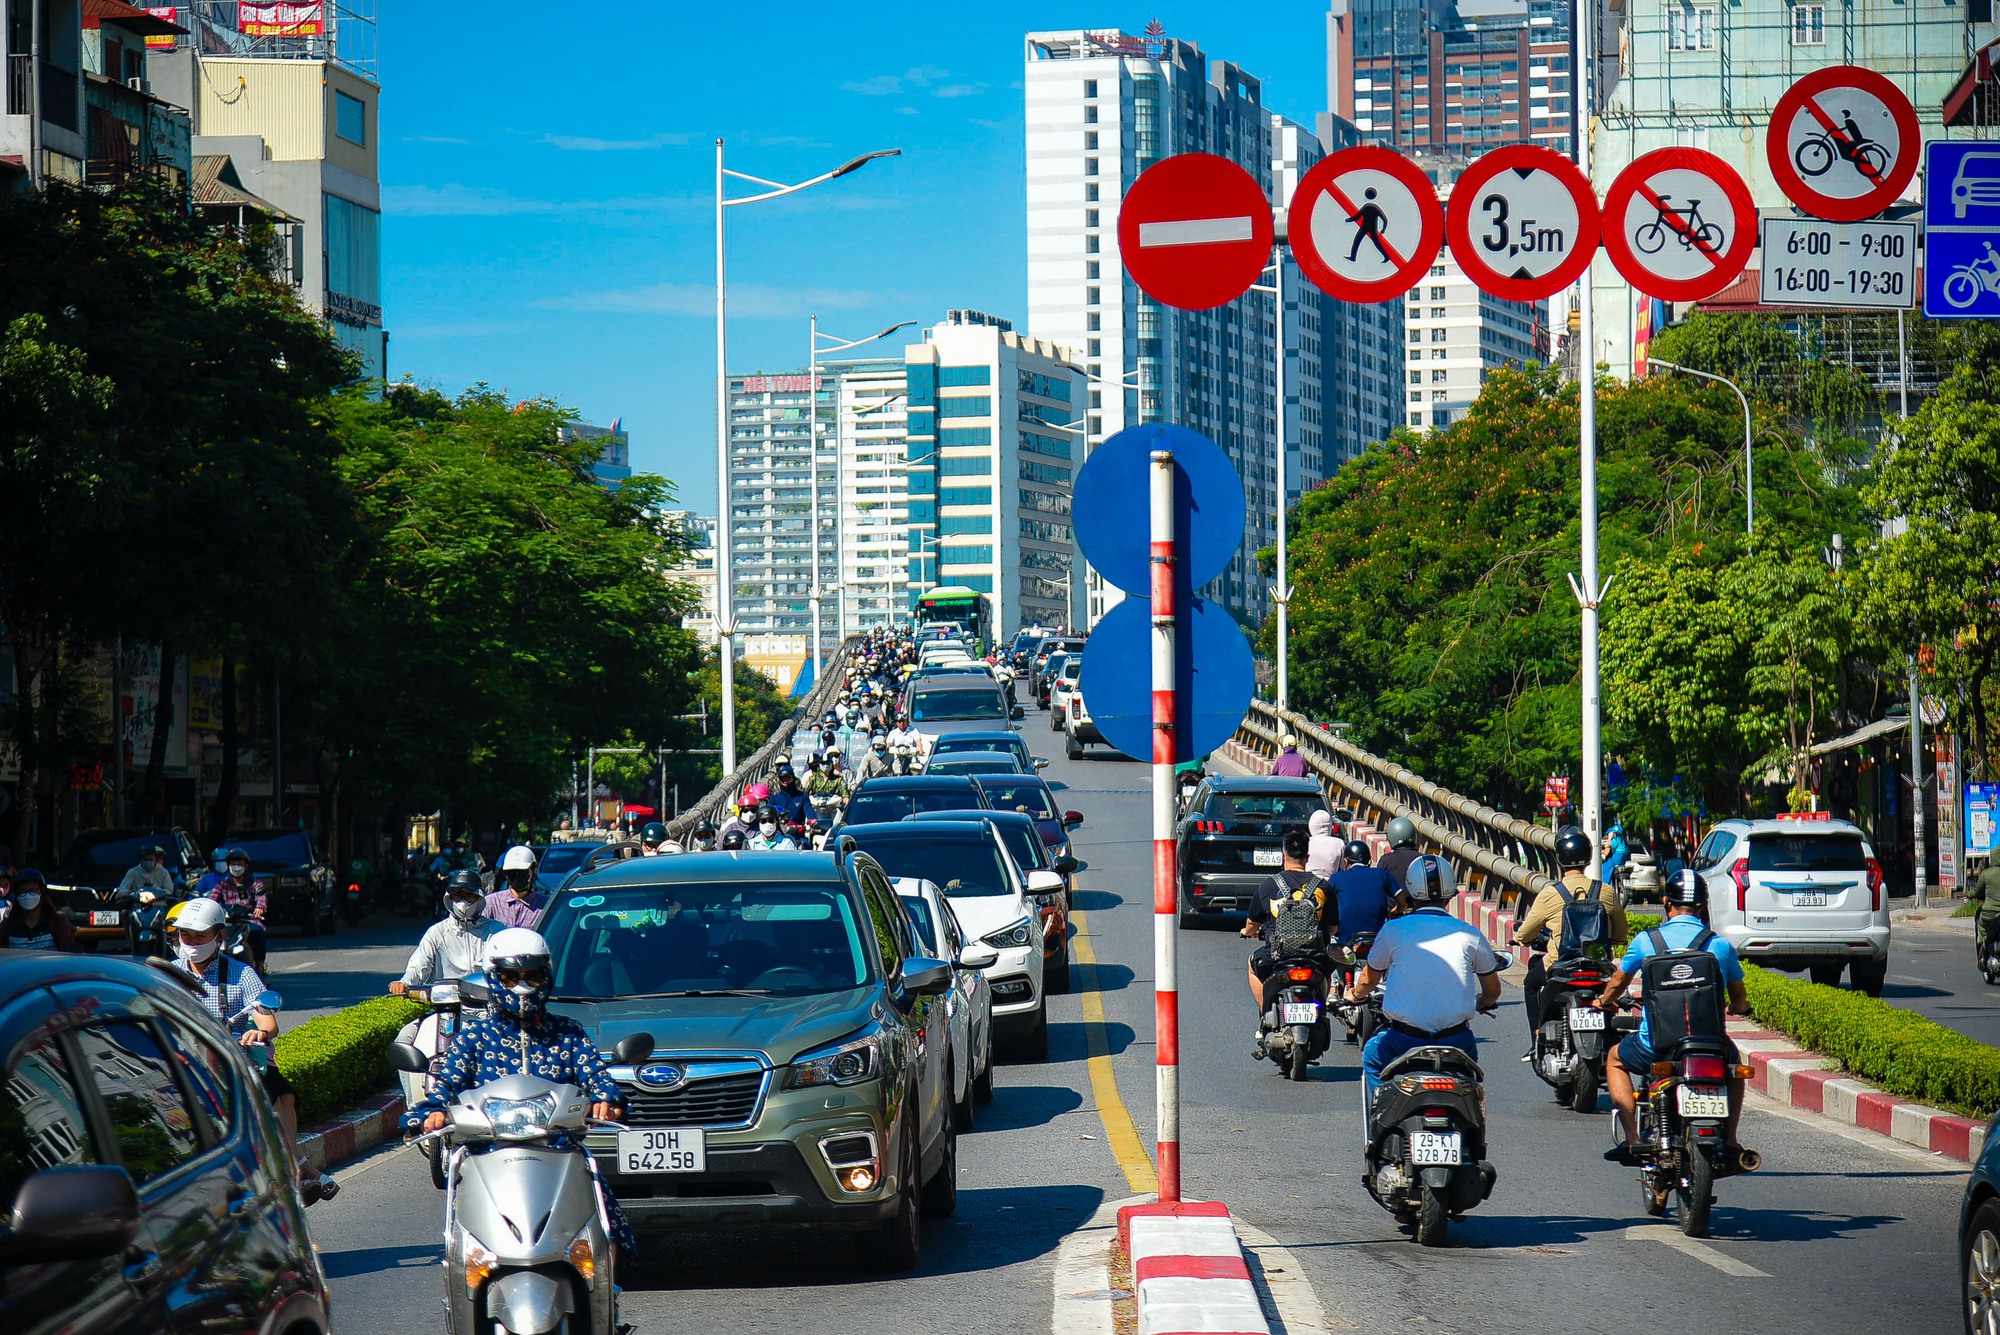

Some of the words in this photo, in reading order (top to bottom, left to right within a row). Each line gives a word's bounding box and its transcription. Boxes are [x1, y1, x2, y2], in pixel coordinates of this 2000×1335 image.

[241, 6, 256, 21] CHO
[1482, 193, 1564, 259] 3,5m
[1787, 230, 1831, 256] 6:00
[1860, 232, 1905, 259] 9:00
[743, 377, 768, 393] HEI
[771, 374, 823, 392] TOWER
[1684, 1101, 1725, 1115] 656.23
[642, 1131, 679, 1150] 30H
[628, 1151, 694, 1171] 642.58
[1416, 1149, 1458, 1163] 328.78
